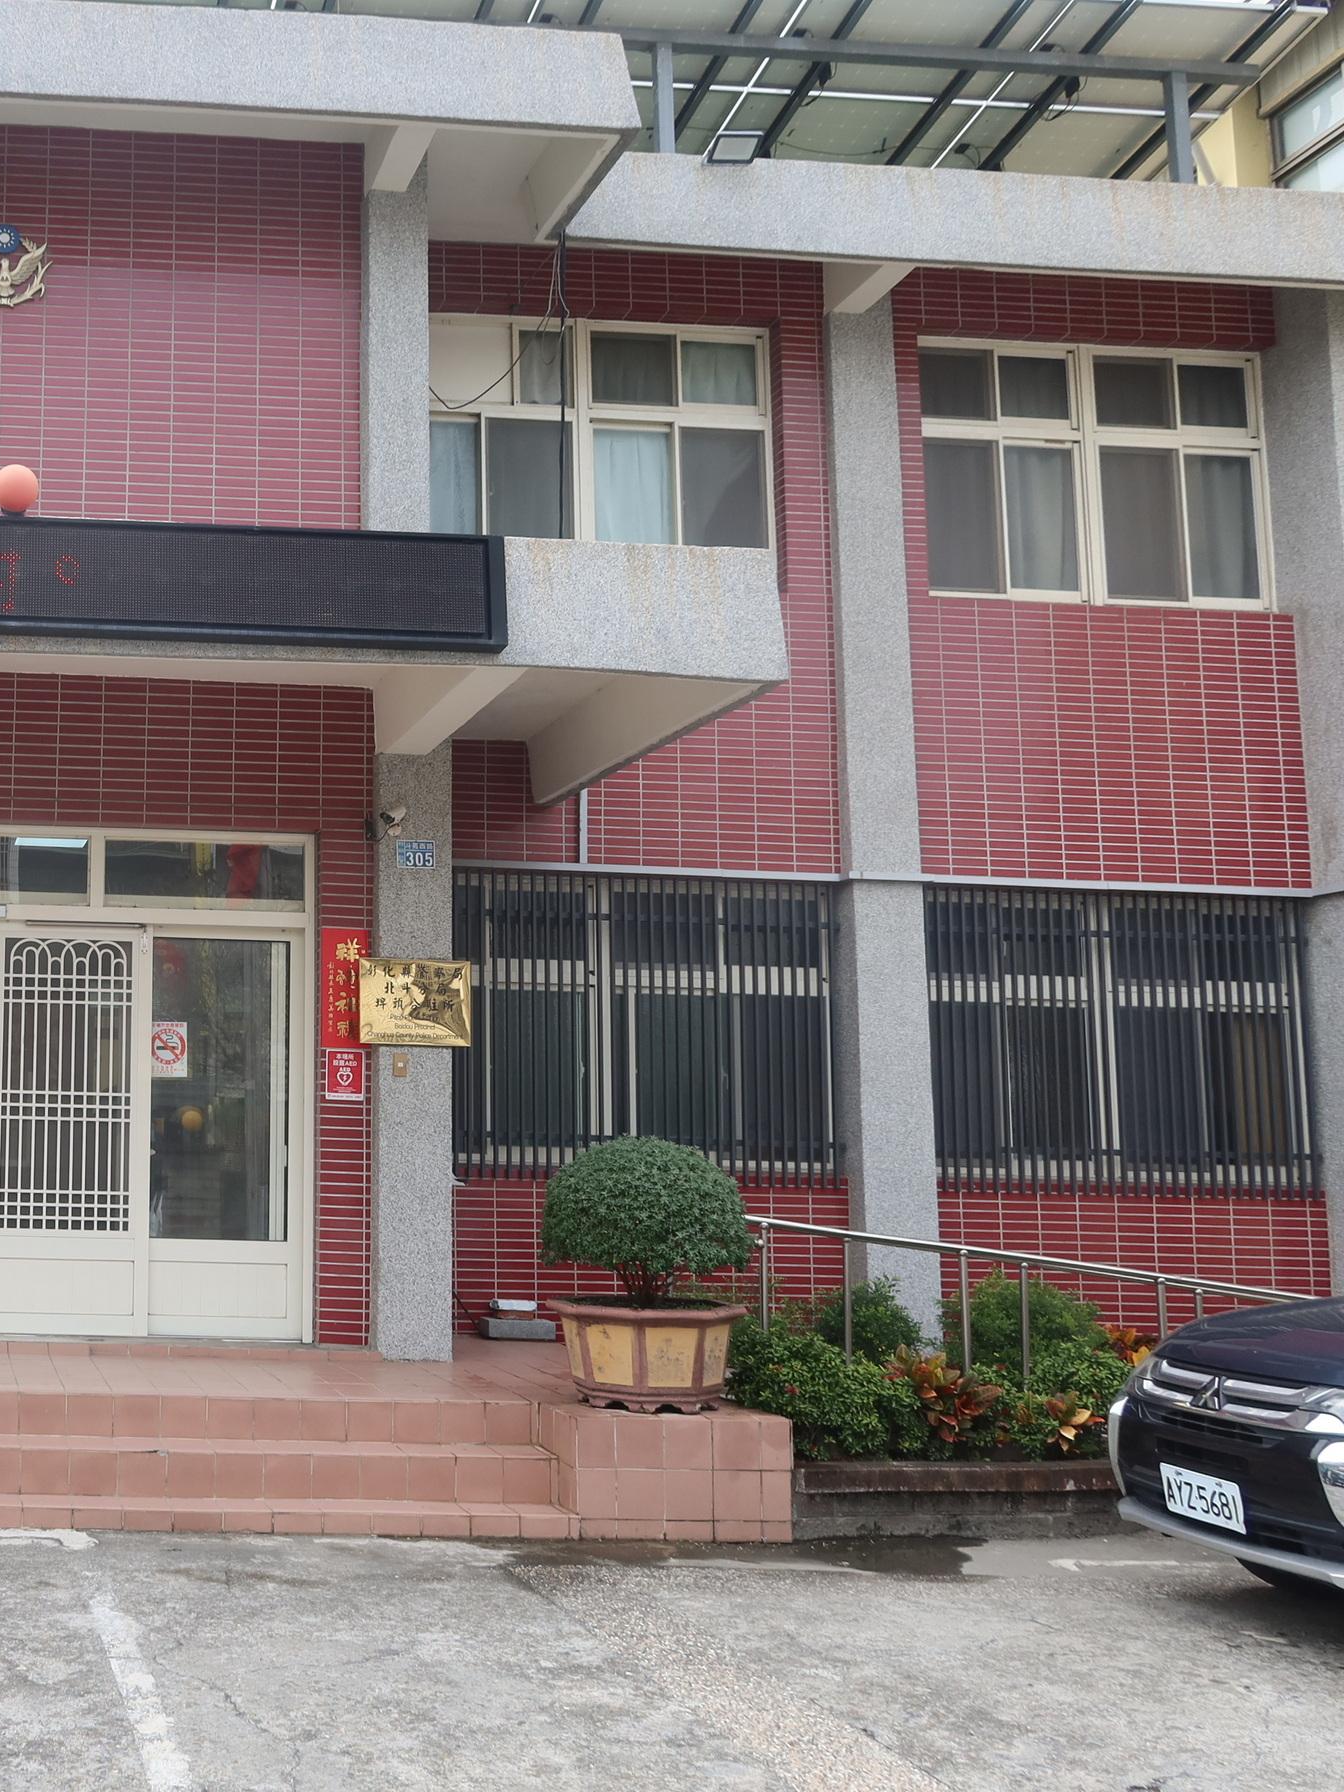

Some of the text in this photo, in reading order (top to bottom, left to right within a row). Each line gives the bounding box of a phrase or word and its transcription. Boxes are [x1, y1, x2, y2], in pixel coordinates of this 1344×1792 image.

[406, 851, 433, 866] 305
[367, 963, 463, 980] 彰化縣警察局
[384, 981, 447, 995] 北斗分局
[1166, 1476, 1241, 1524] AYZ-5681
